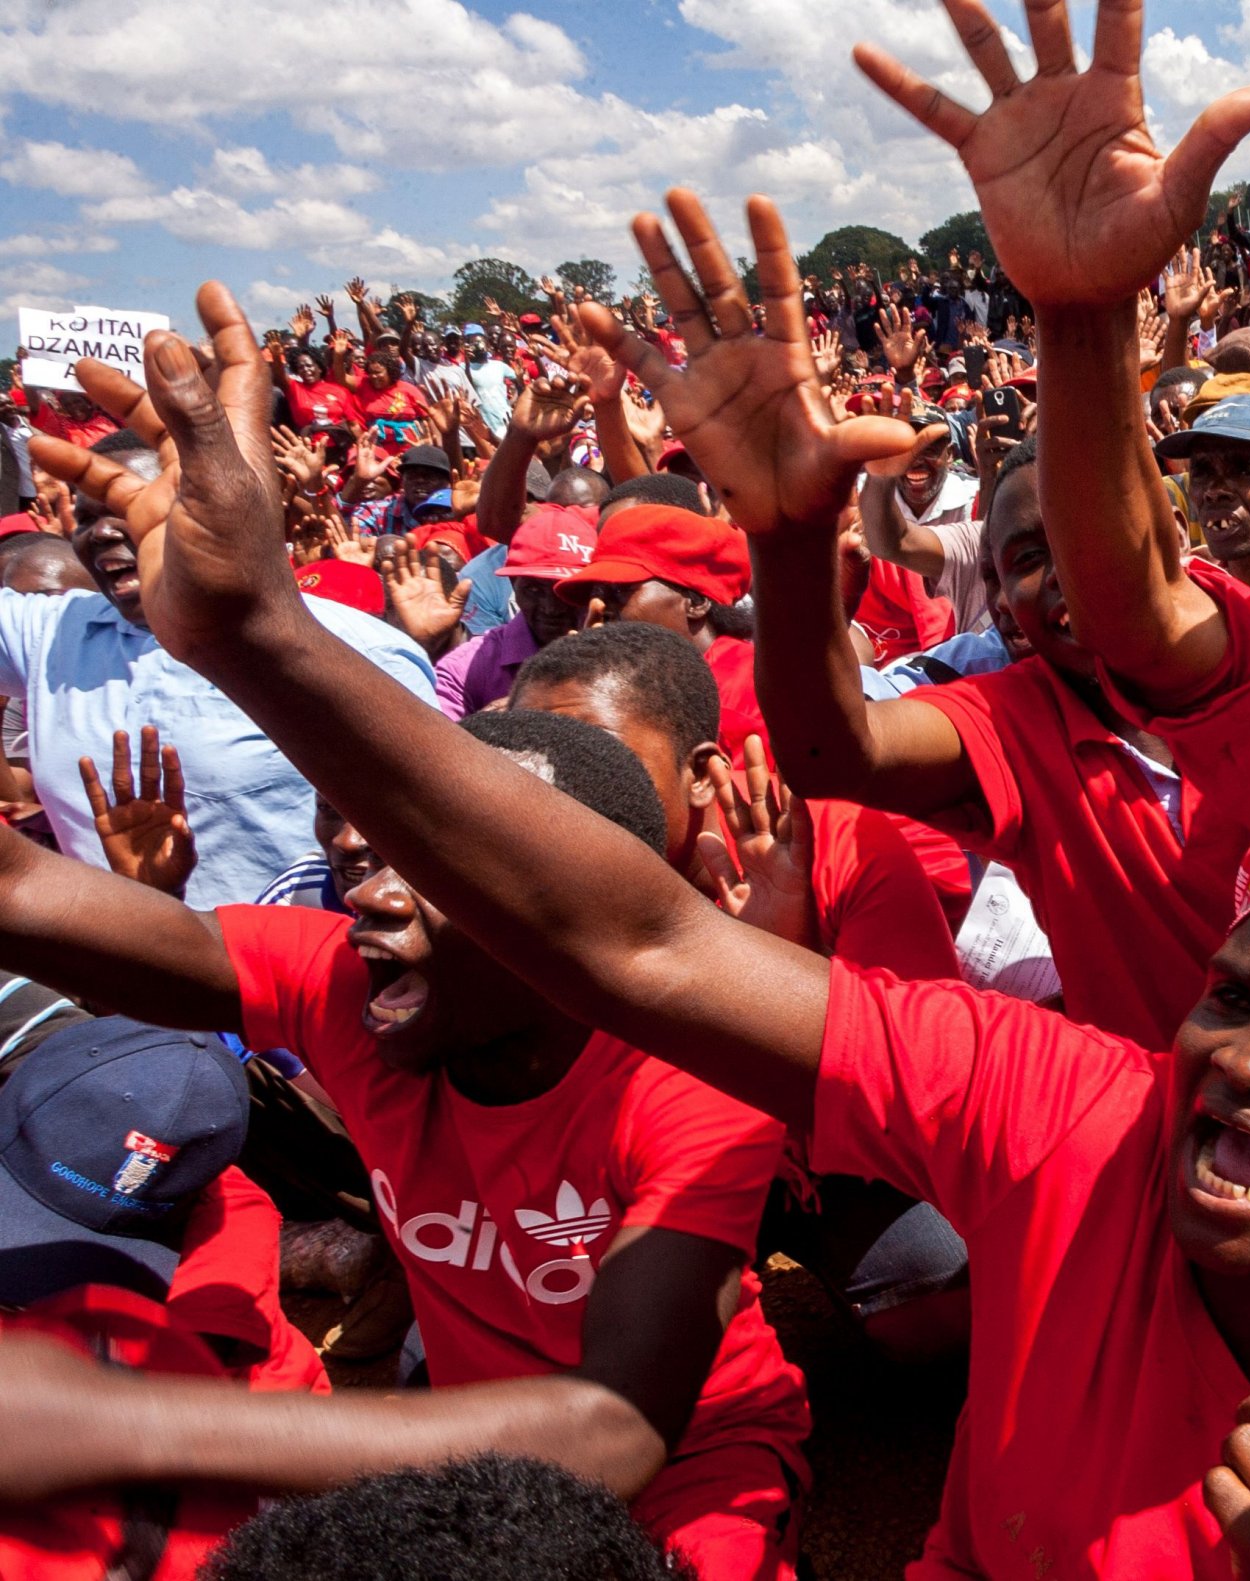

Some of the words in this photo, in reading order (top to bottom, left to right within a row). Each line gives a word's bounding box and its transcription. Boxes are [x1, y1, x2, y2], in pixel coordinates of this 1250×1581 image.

[50, 316, 88, 332] KO
[99, 318, 142, 339] ITAI
[28, 335, 142, 364] DZAMAR
[557, 533, 595, 563] NY
[371, 1168, 597, 1305] adia
